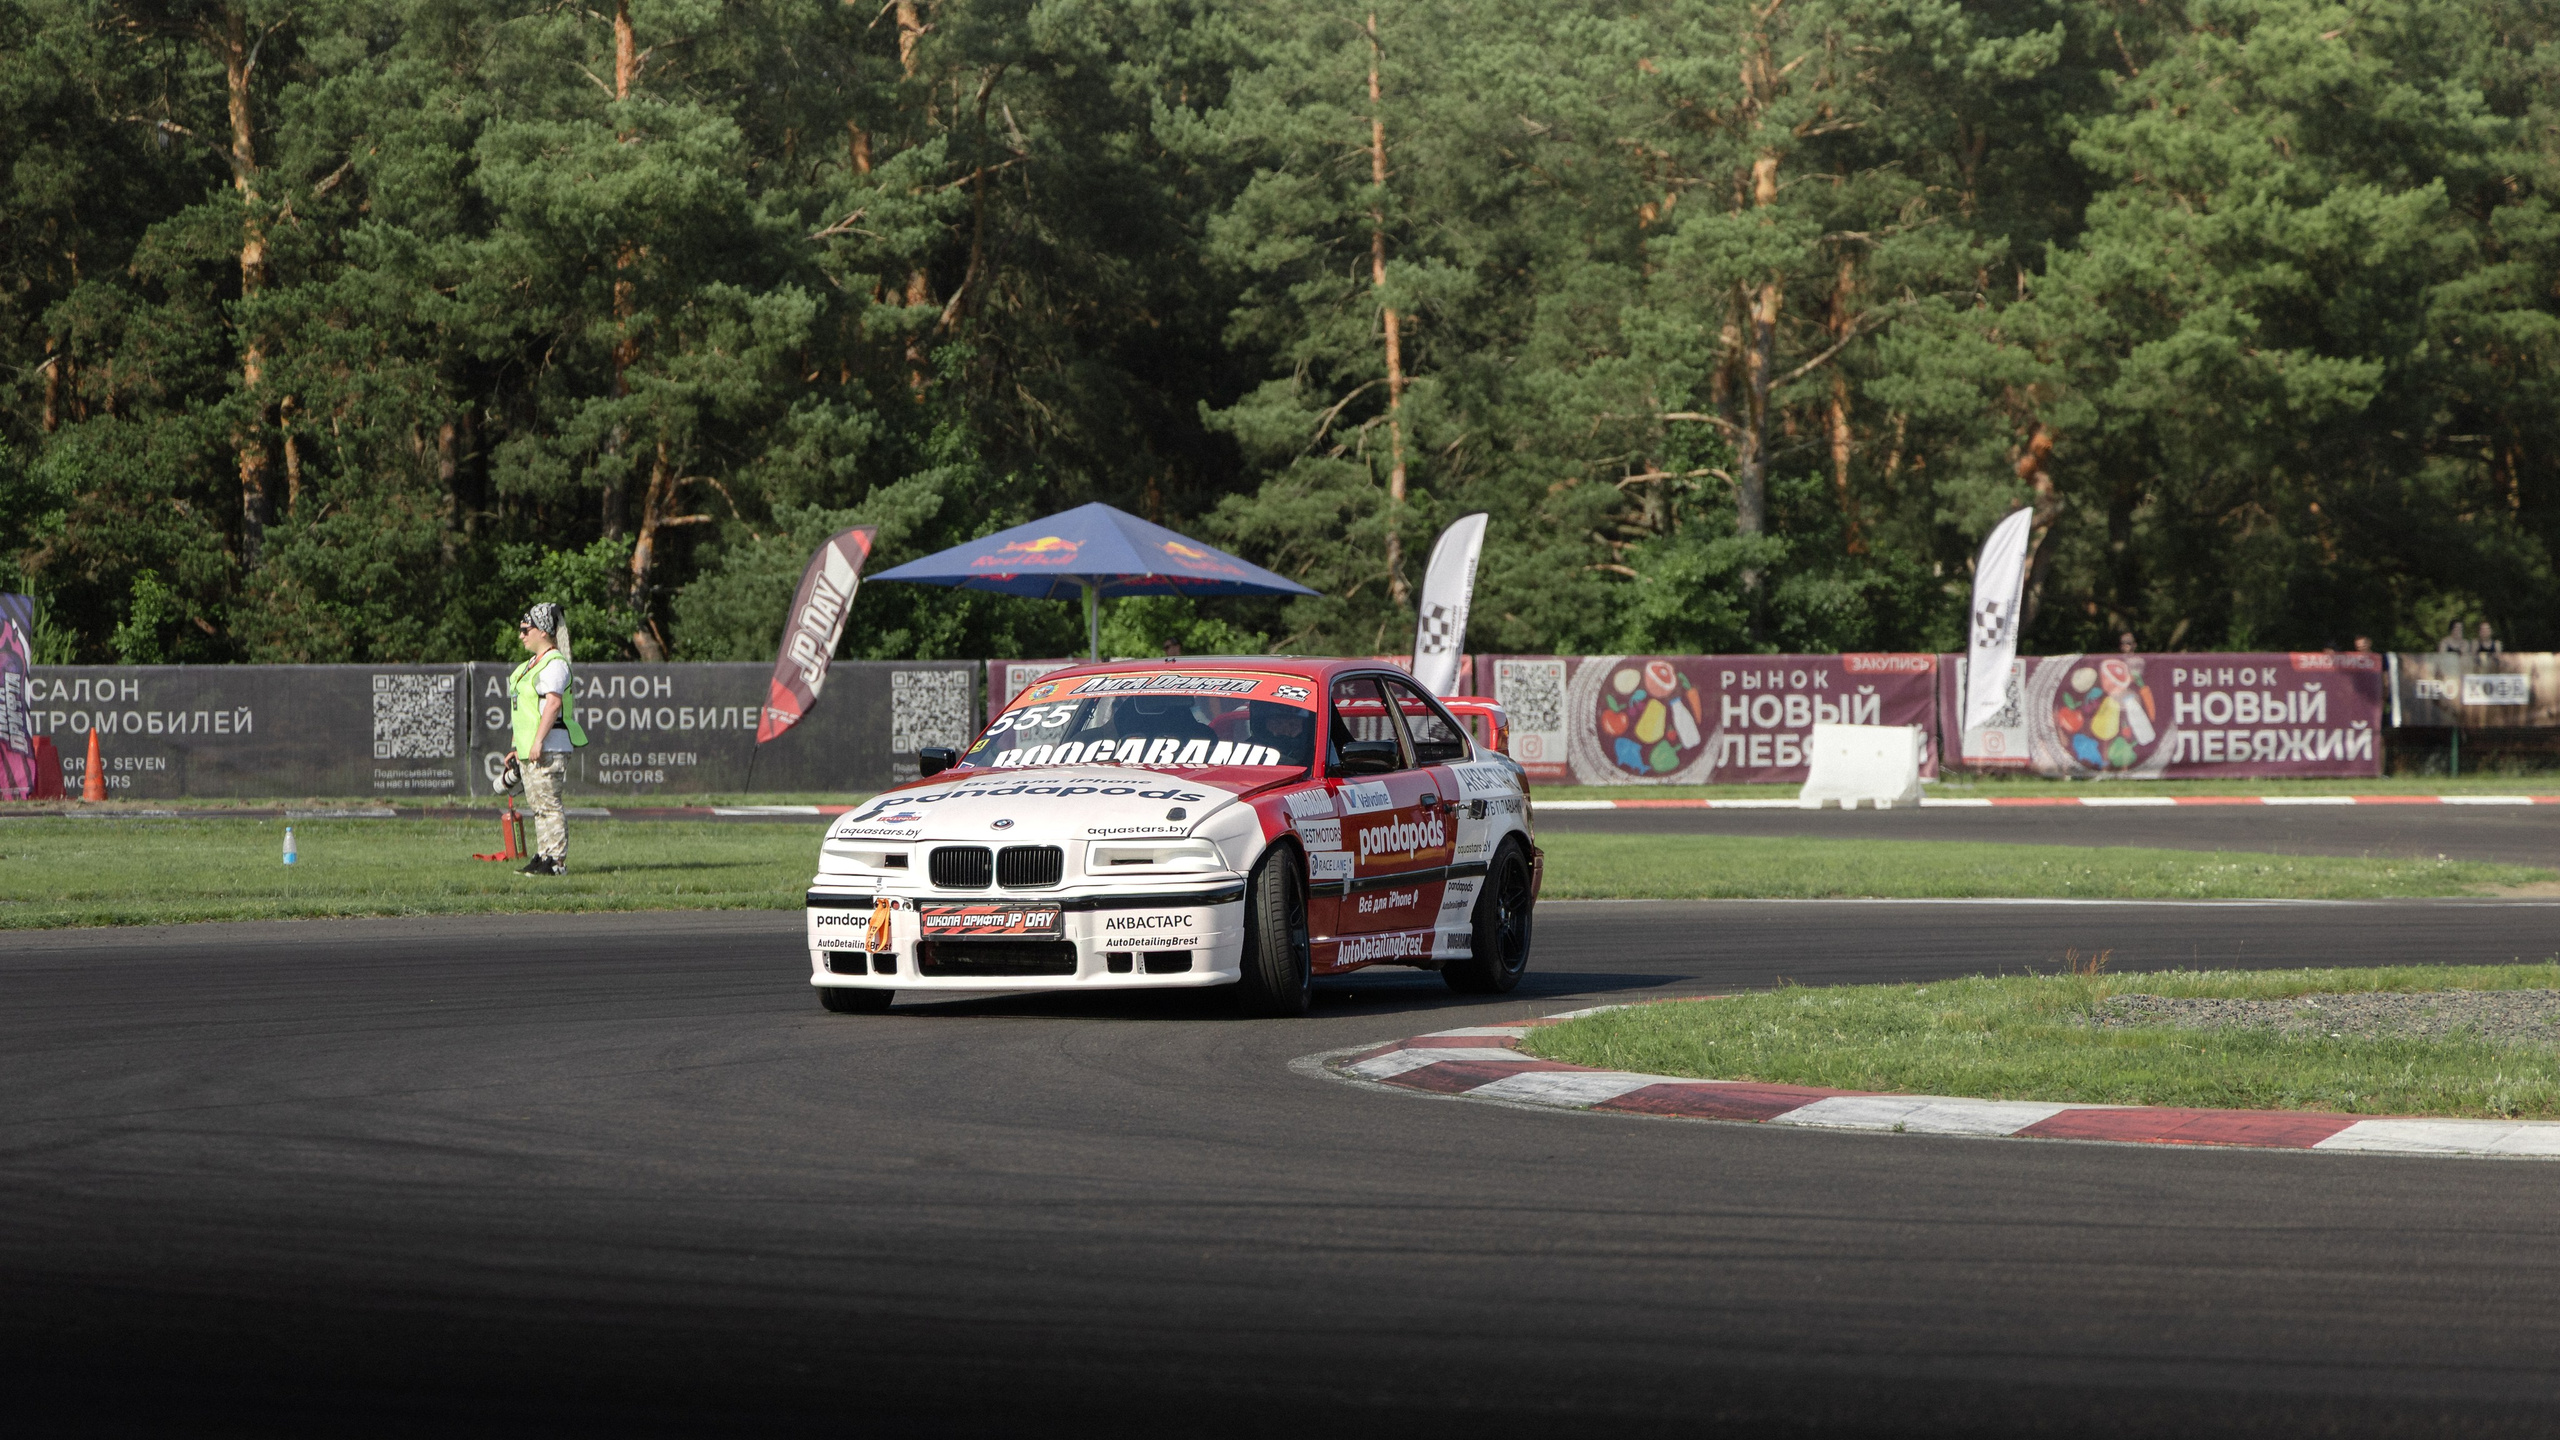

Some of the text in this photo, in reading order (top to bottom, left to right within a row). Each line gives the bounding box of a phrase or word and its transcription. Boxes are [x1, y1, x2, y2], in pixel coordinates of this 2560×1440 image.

[788, 570, 847, 684] JP DAY
[1852, 657, 1930, 671] ЗАКУПИСЬ
[1720, 669, 1829, 690] РЫНОК
[2172, 667, 2277, 687] РЫНОК
[1720, 685, 1881, 728] НОВЫЙ
[2173, 682, 2327, 725] НОВЫЙ
[986, 705, 1080, 736] 555
[2171, 720, 2373, 764] ЛЕБЯЖИЙ
[63, 757, 166, 770] GRD SEVEN
[599, 752, 698, 766] GRAD SEVEN
[412, 779, 454, 788] Instagram
[599, 770, 664, 783] MOTORS
[873, 784, 1206, 811] pandapods
[1357, 792, 1390, 808] Valvoline
[840, 827, 922, 839] aquastars.by
[1088, 826, 1188, 837] aquastars.by
[1359, 810, 1445, 866] pandapods
[1319, 859, 1347, 871] RACE LANE
[1447, 881, 1473, 894] pandapods
[1359, 890, 1412, 914] Всё для iPhone
[927, 911, 1056, 928] ШКОЛА ДРИФТА JP DAY
[1105, 915, 1193, 930] АКВАСТАРС
[1105, 937, 1198, 947] AutoDetailingBrest
[1337, 933, 1424, 966] AutoDetailingBrest
